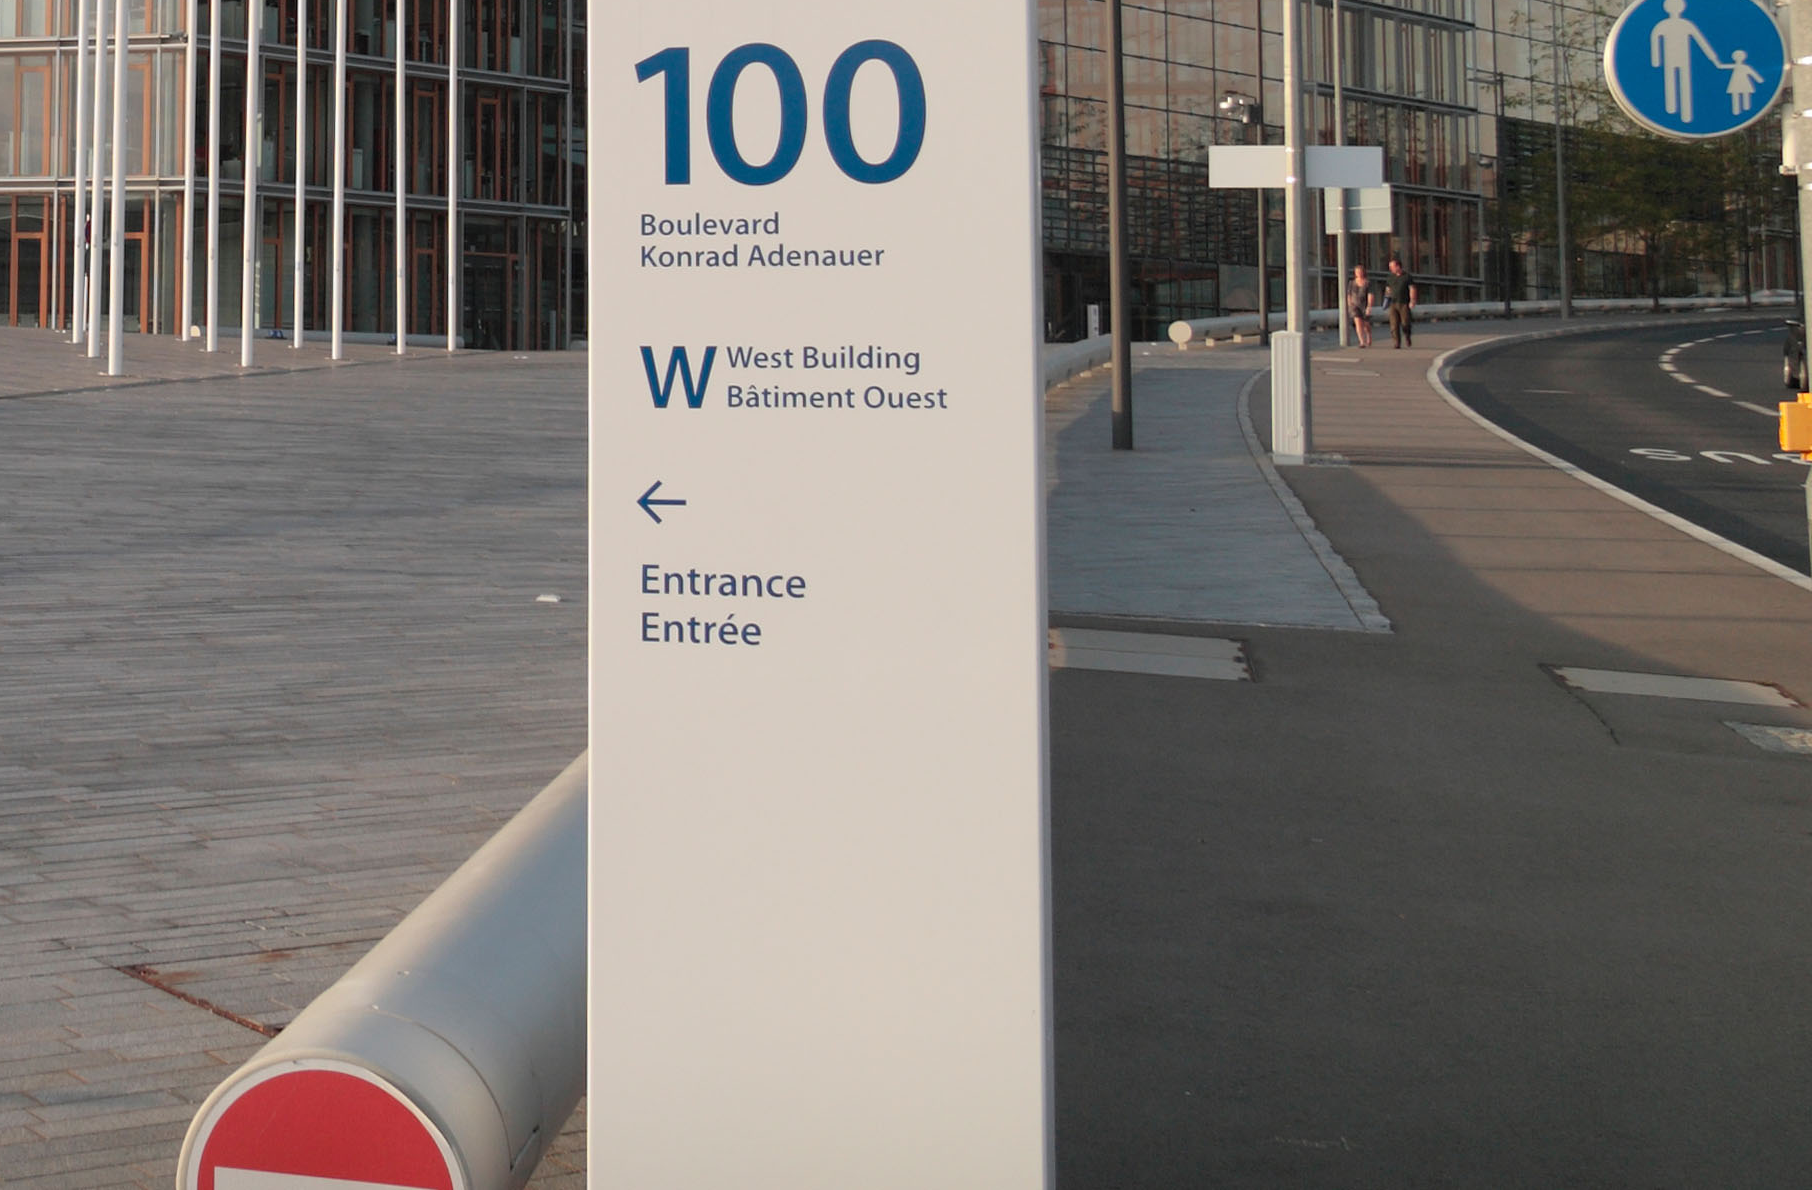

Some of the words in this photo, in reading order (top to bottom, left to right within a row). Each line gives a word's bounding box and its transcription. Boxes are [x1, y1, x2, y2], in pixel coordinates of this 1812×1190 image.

[634, 38, 927, 187] 100
[640, 212, 780, 236] Boulevard
[640, 244, 738, 268] Konrad
[748, 244, 885, 267] Adenauer
[726, 345, 793, 370] West
[802, 345, 921, 376] Building
[640, 345, 718, 410] W
[727, 384, 855, 410] Bâtiment
[863, 384, 948, 410] Ouest
[641, 564, 807, 599] Entrance
[641, 611, 762, 646] Entrée
